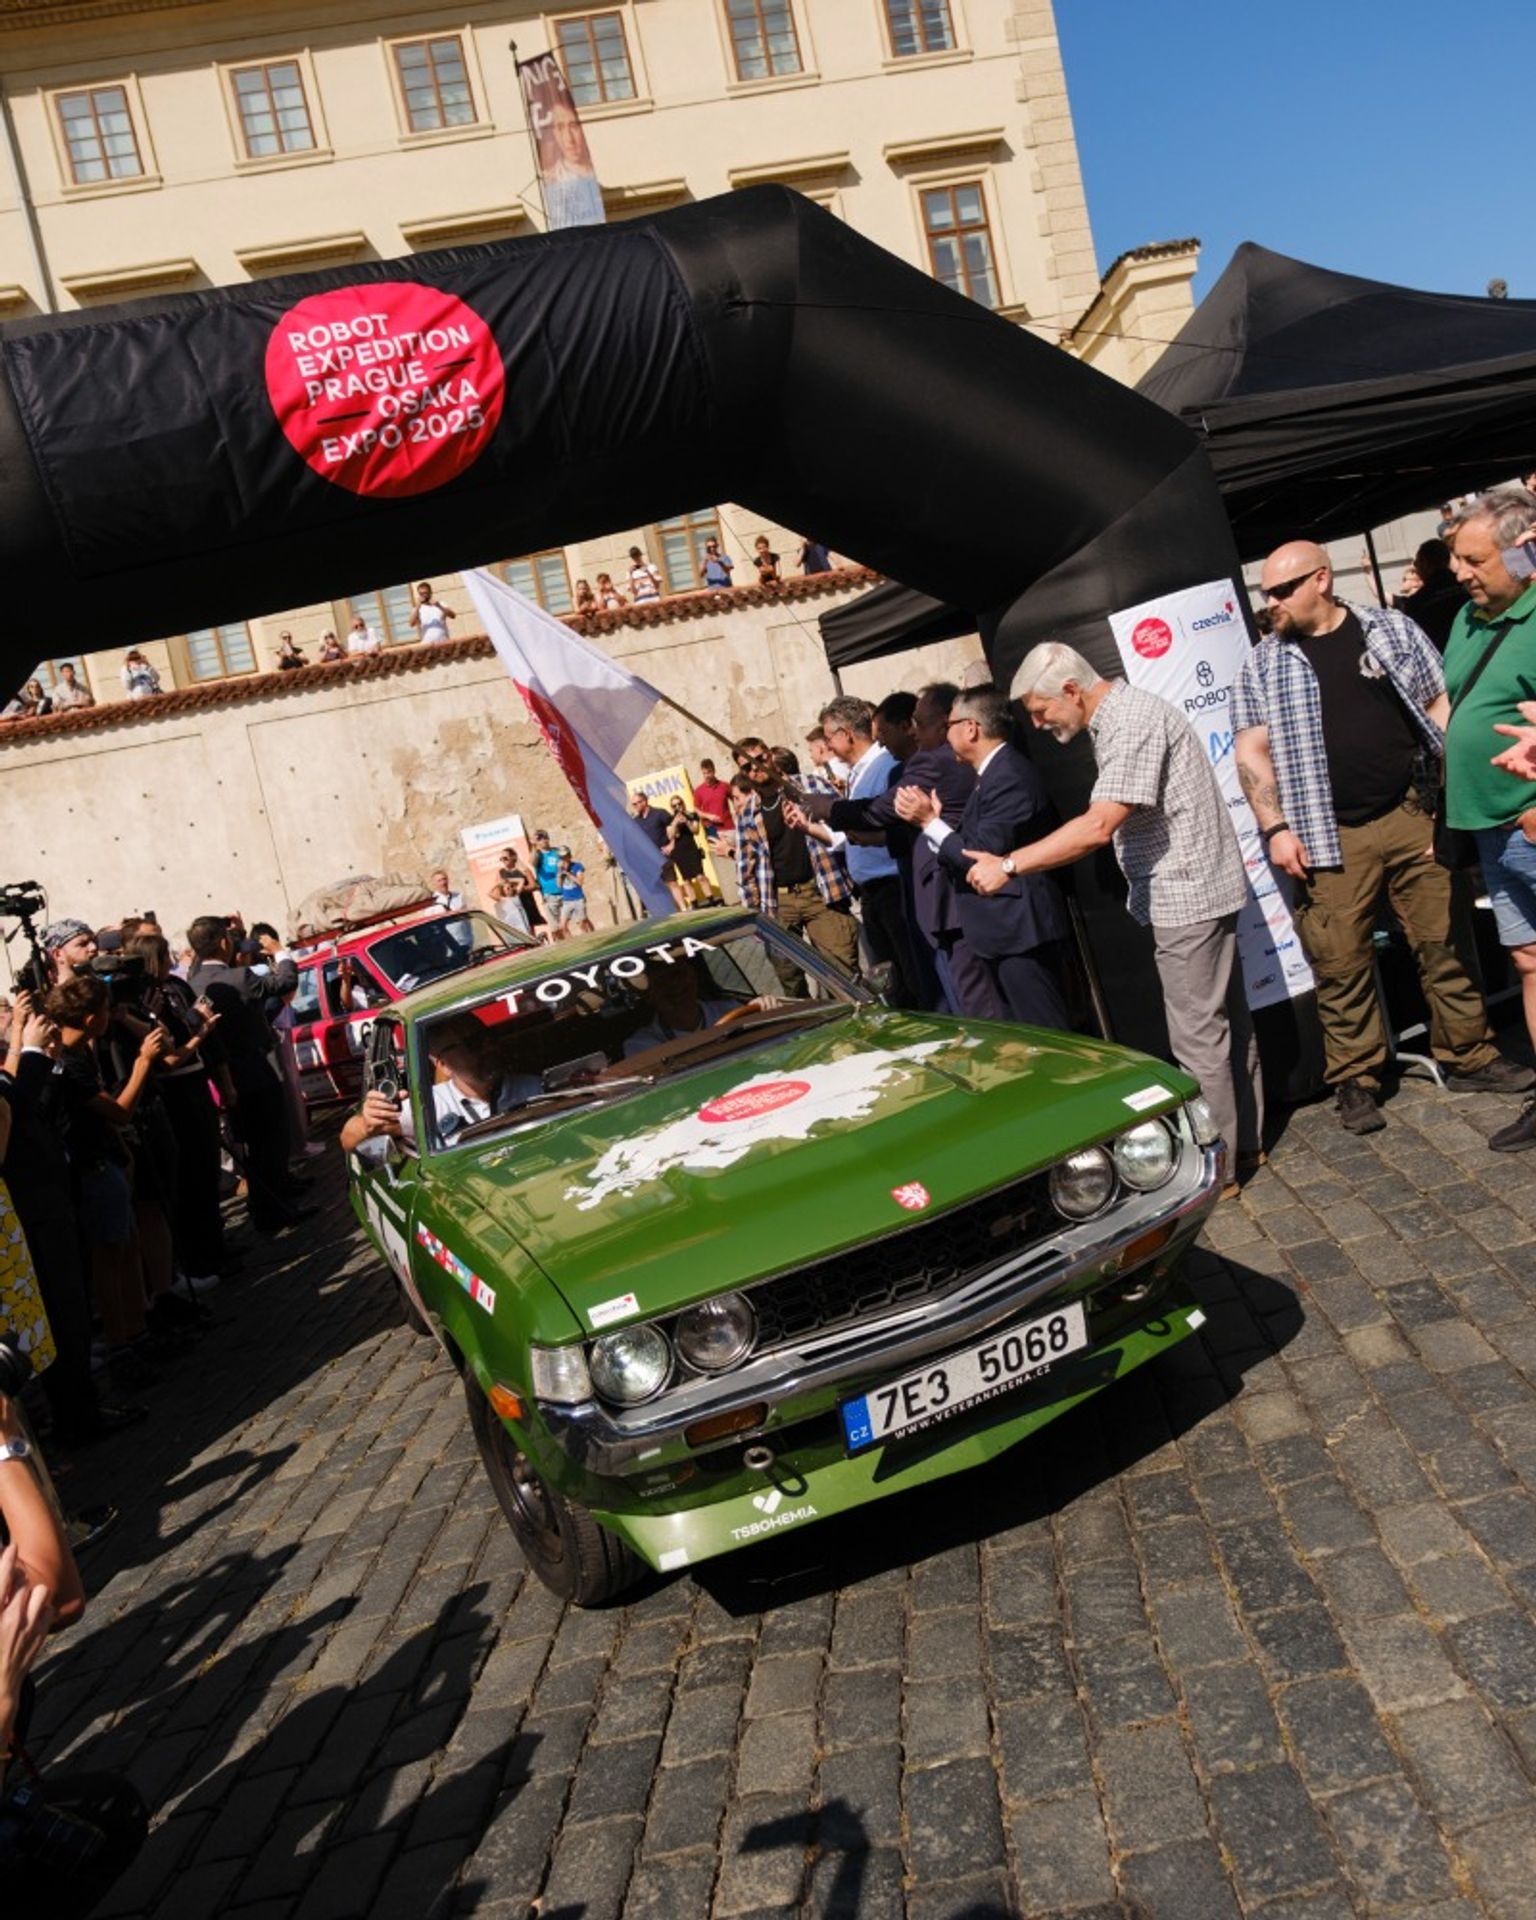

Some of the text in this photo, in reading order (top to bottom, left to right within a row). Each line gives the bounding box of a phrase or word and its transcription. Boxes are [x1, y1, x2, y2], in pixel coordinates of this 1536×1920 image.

[288, 314, 388, 352] ROBOT
[296, 325, 471, 377] EXPEDITION
[305, 361, 428, 406] PRAGUE
[377, 378, 479, 418] OSAKA
[322, 405, 485, 463] EXPO 2025
[1192, 610, 1232, 631] czechia
[496, 936, 717, 1014] TOYOTA
[877, 1315, 1069, 1429] 7E3 5068
[894, 1365, 1052, 1440] WWW.VETERANARENA.CZ
[850, 1426, 869, 1442] CZ
[731, 1505, 818, 1540] TSBOHEMIA
